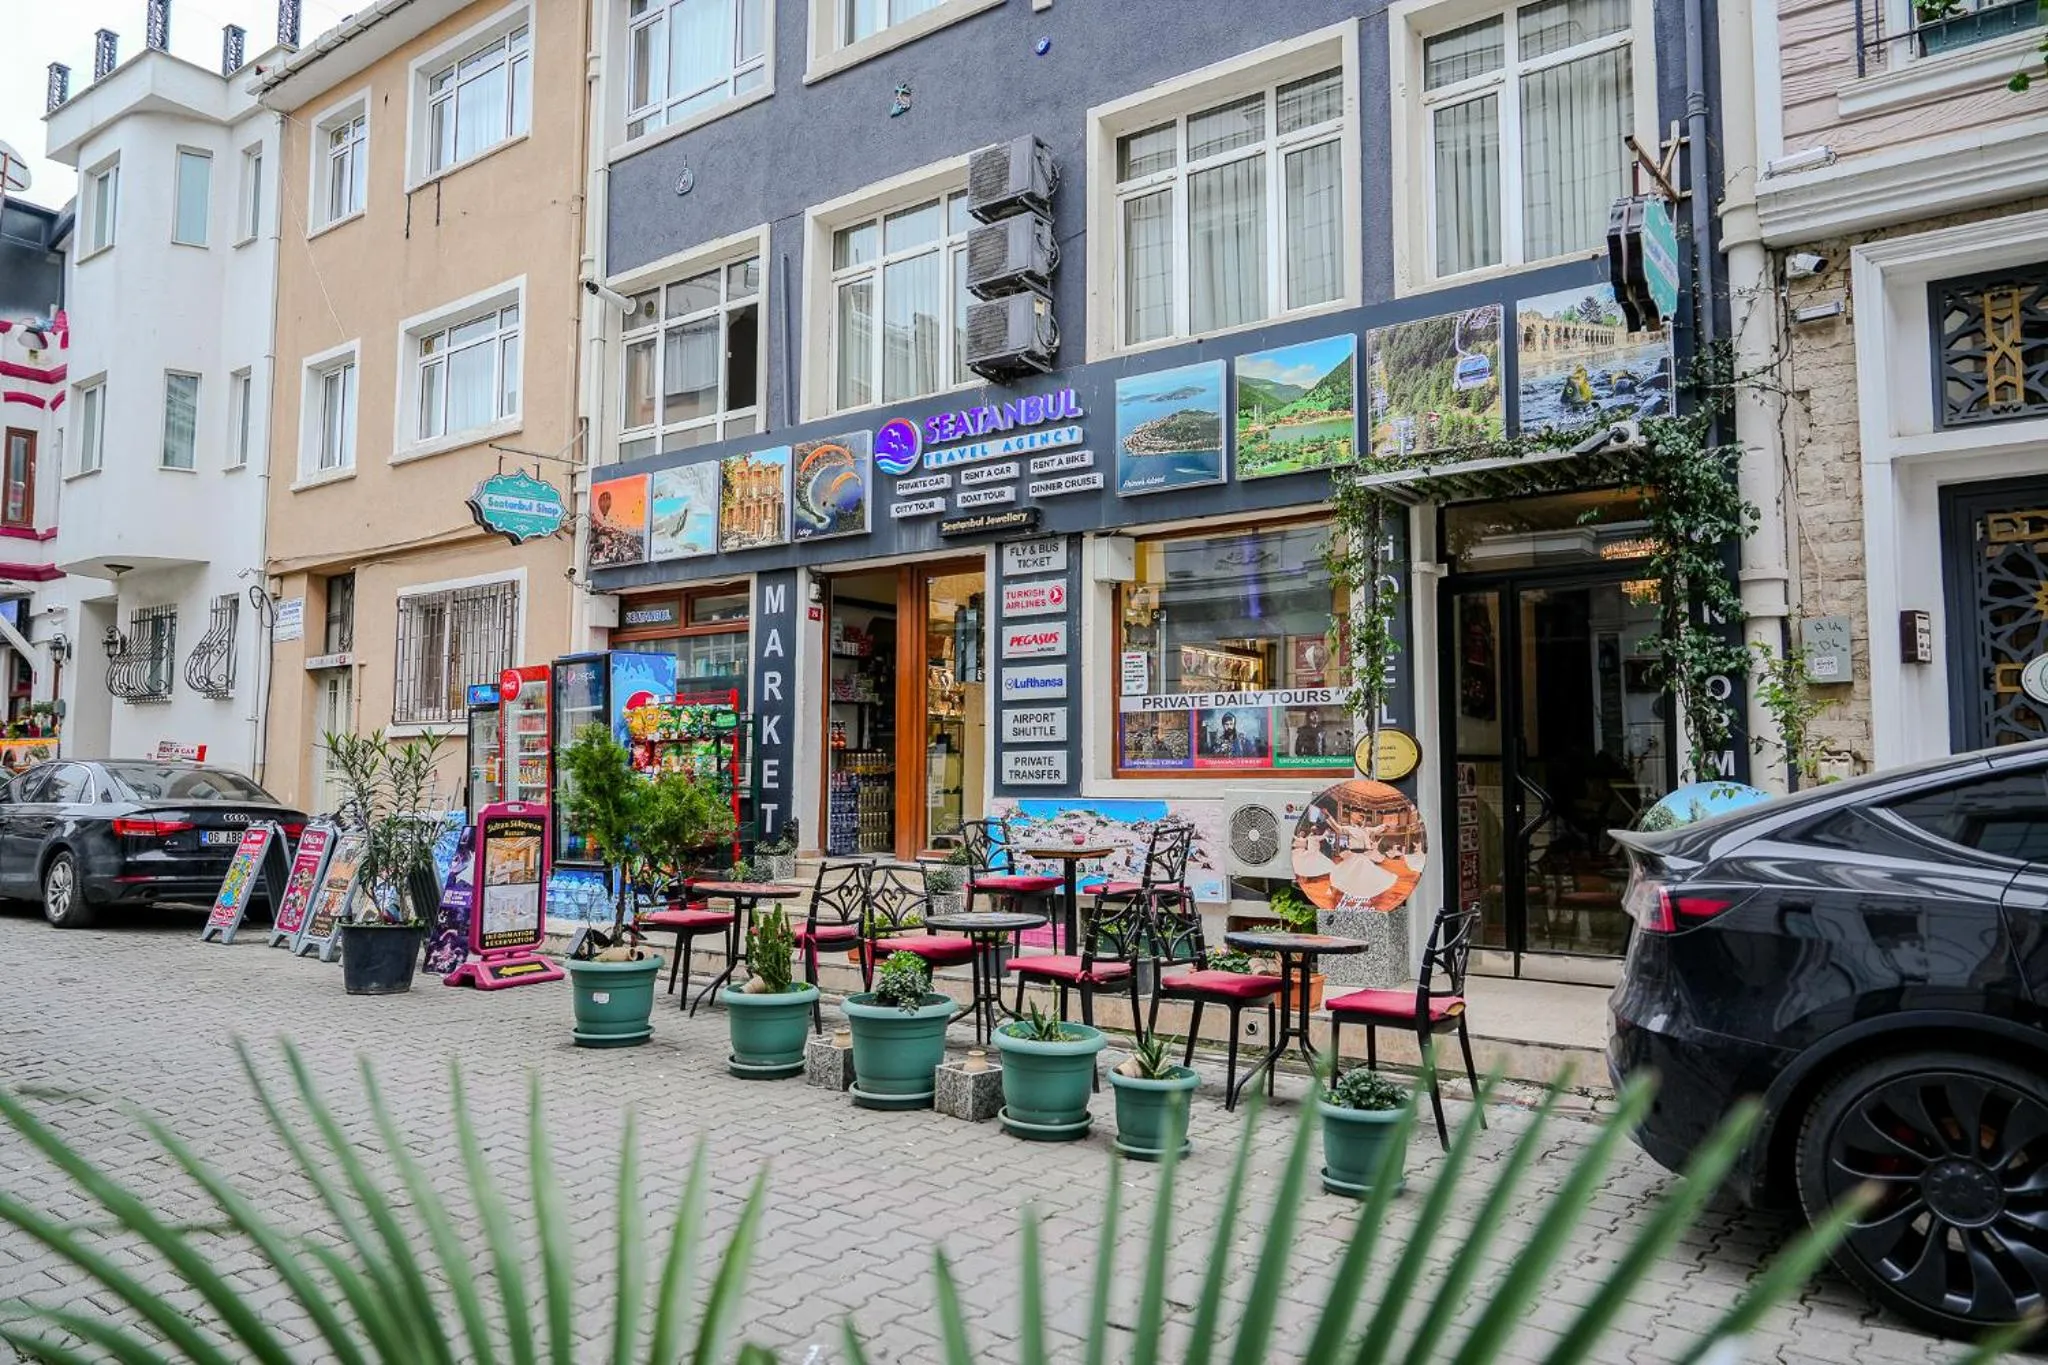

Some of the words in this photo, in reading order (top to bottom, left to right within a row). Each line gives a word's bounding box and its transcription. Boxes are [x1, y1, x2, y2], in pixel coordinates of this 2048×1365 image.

[924, 386, 1083, 444] SEATANBUL
[924, 443, 988, 468] TRAVEL
[1003, 427, 1077, 451] AGENCY
[1032, 458, 1054, 470] RENT
[1065, 453, 1085, 465] BIKE
[964, 469, 984, 481] RENT
[993, 466, 1011, 477] CAR
[897, 478, 927, 492] PRIVATE
[929, 476, 945, 488] CAR
[1031, 481, 1062, 495] DINNER
[1064, 475, 1098, 489] CRUISE
[961, 492, 982, 505] BOAT
[983, 490, 1006, 502] TOUR
[536, 502, 559, 517] Shop
[895, 503, 913, 514] CITY
[914, 500, 935, 512] TOUR
[941, 516, 984, 532] Seatanbul
[985, 511, 1029, 527] Jewellery
[1009, 546, 1027, 557] FLY
[1029, 545, 1037, 555] &
[1039, 542, 1059, 554] BUS
[1017, 556, 1052, 569] TICKET
[1005, 588, 1046, 600] TURKISH
[1005, 599, 1047, 610] AIRLINES
[1009, 631, 1060, 647] PEGASUS
[1015, 677, 1063, 689] Lufthansa
[1142, 694, 1209, 710] PRIVATE
[1214, 692, 1264, 707] DAILY
[1268, 689, 1332, 705] TOURS
[761, 583, 786, 833] MARKET
[1012, 712, 1055, 724] AIRPORT
[1012, 725, 1056, 737] SHUTTLE
[1014, 756, 1054, 767] PRIVATE
[1009, 769, 1061, 780] TRANSFER
[208, 833, 219, 843] 06
[485, 937, 535, 947] RESERVATION
[486, 930, 535, 940] INFORMATION
